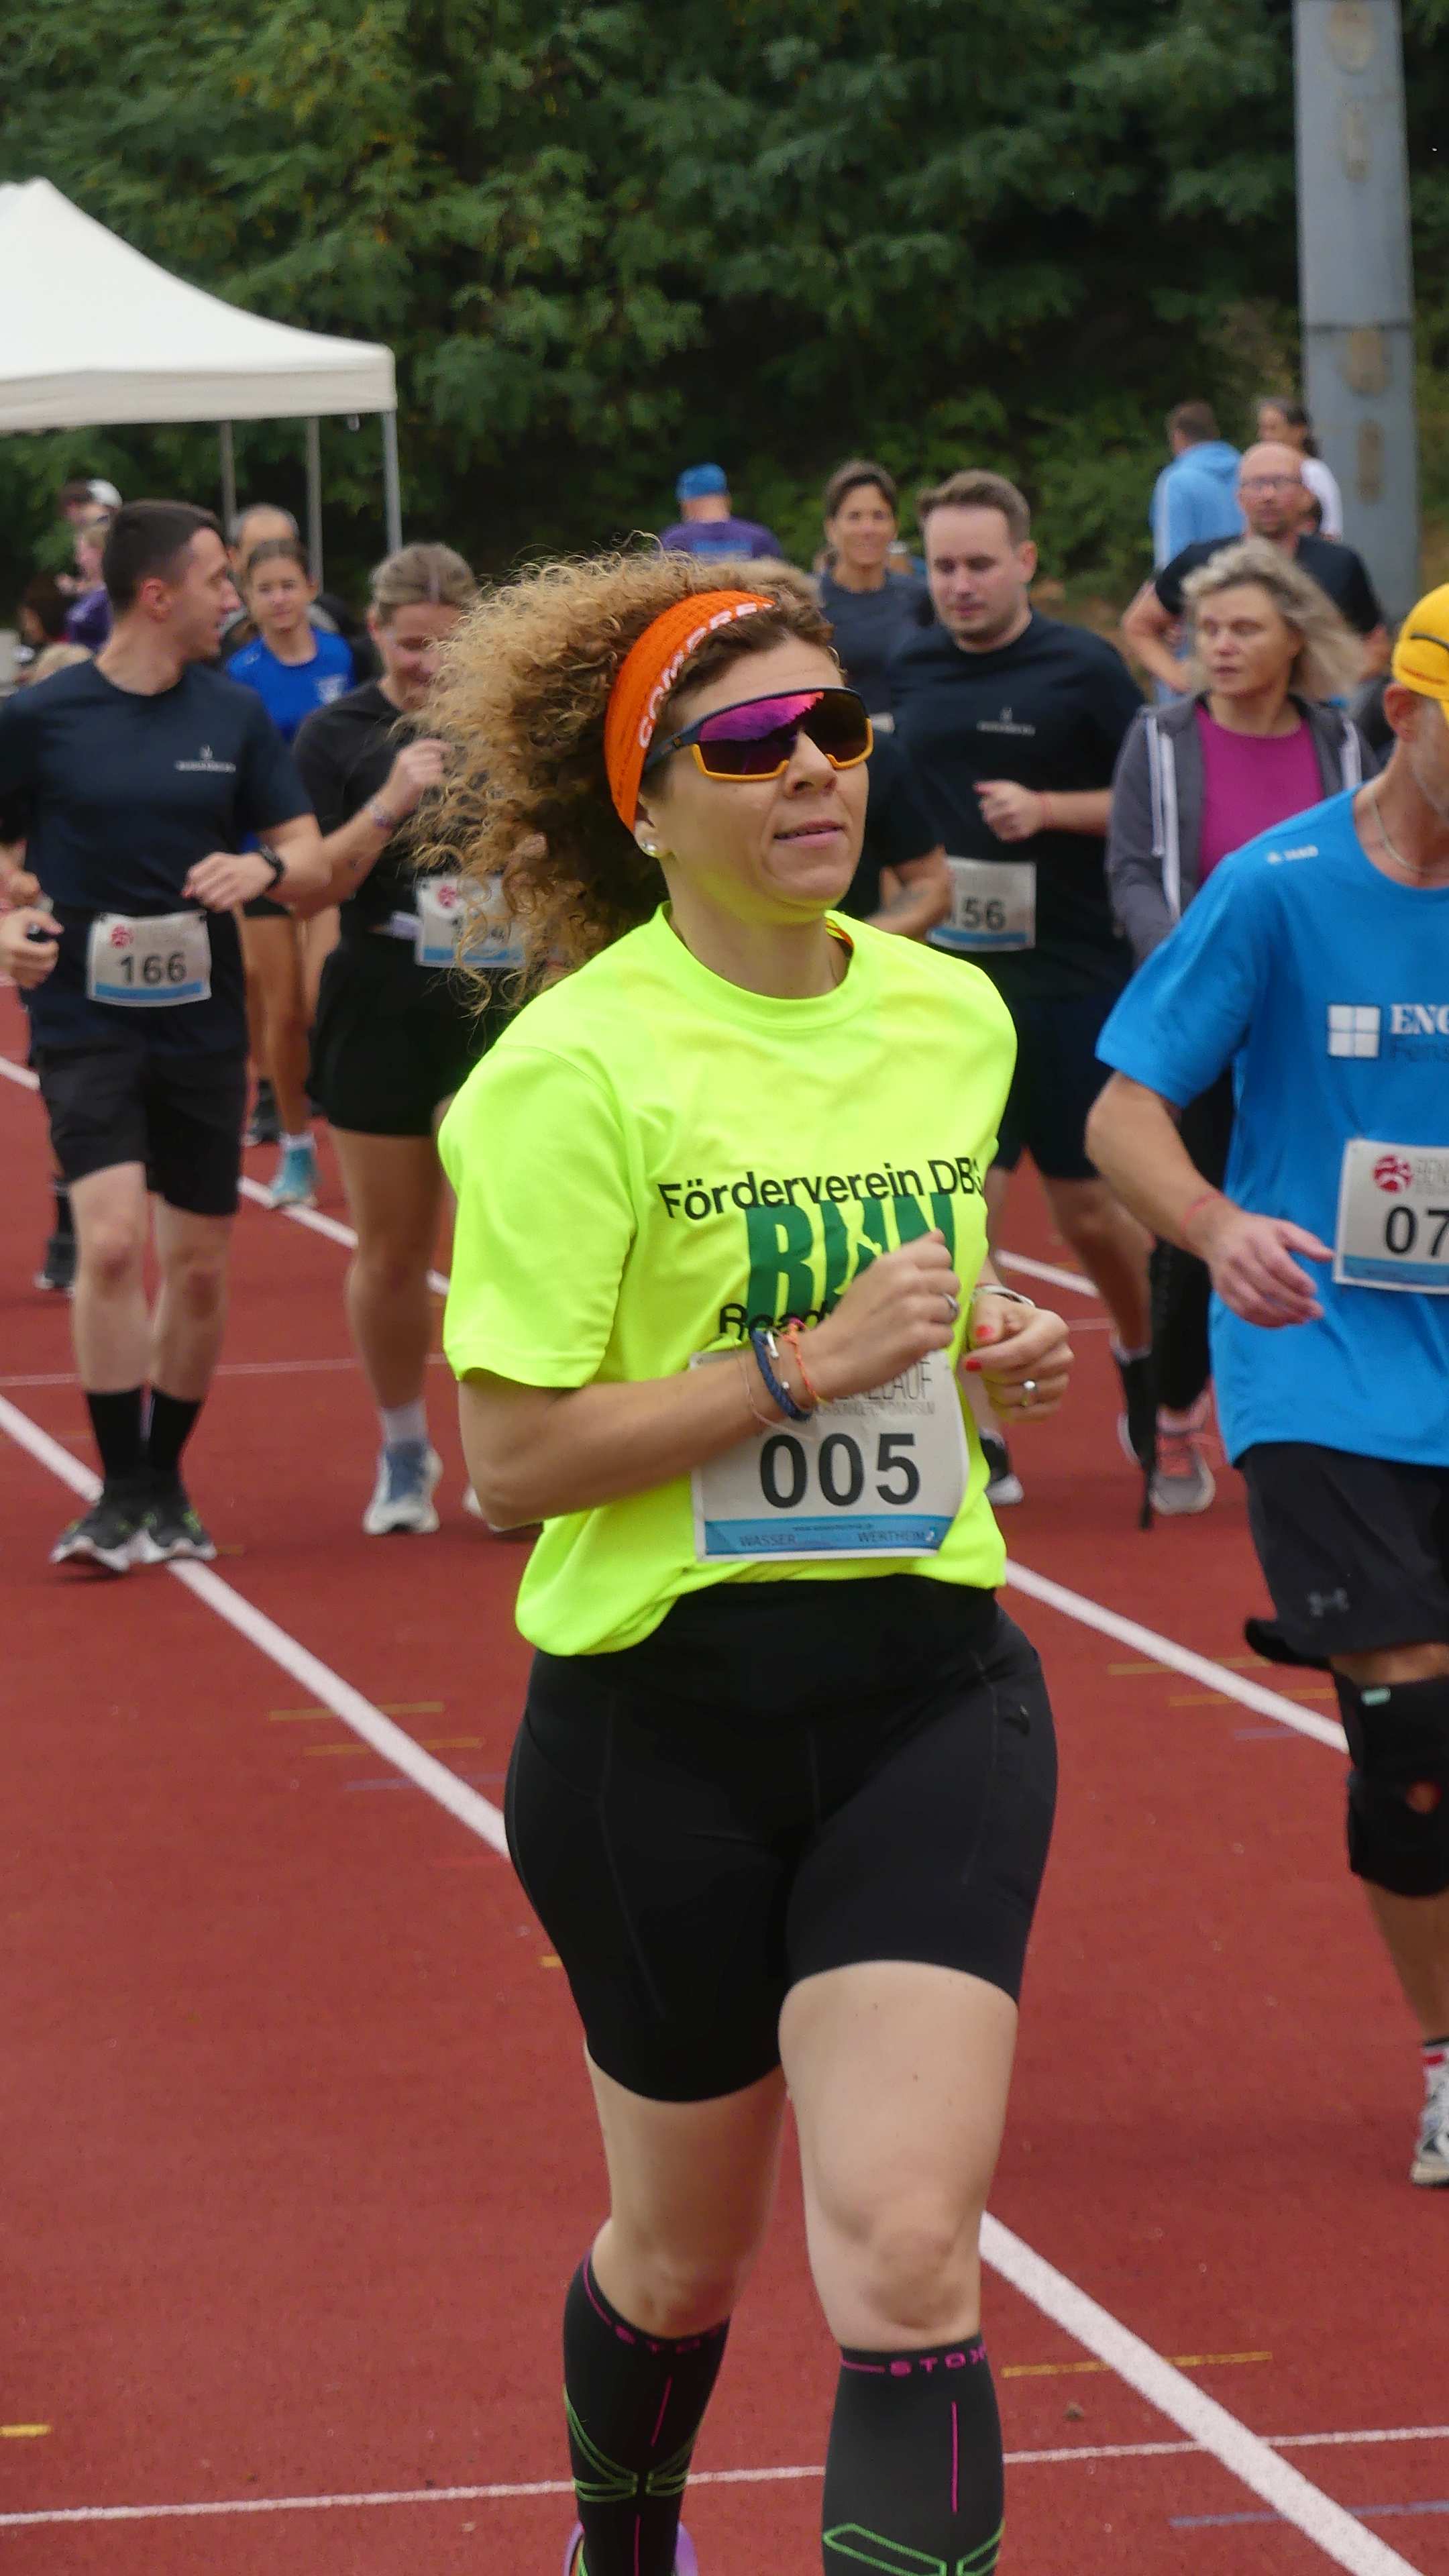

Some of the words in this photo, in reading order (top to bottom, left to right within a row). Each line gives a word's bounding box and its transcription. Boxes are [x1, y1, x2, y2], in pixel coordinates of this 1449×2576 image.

[959, 897, 1006, 930] 56
[120, 952, 187, 985] 166
[656, 1163, 924, 1221] Förderverein
[745, 1192, 955, 1320] RUN
[1385, 1206, 1449, 1256] 07
[760, 1433, 920, 1508] 005
